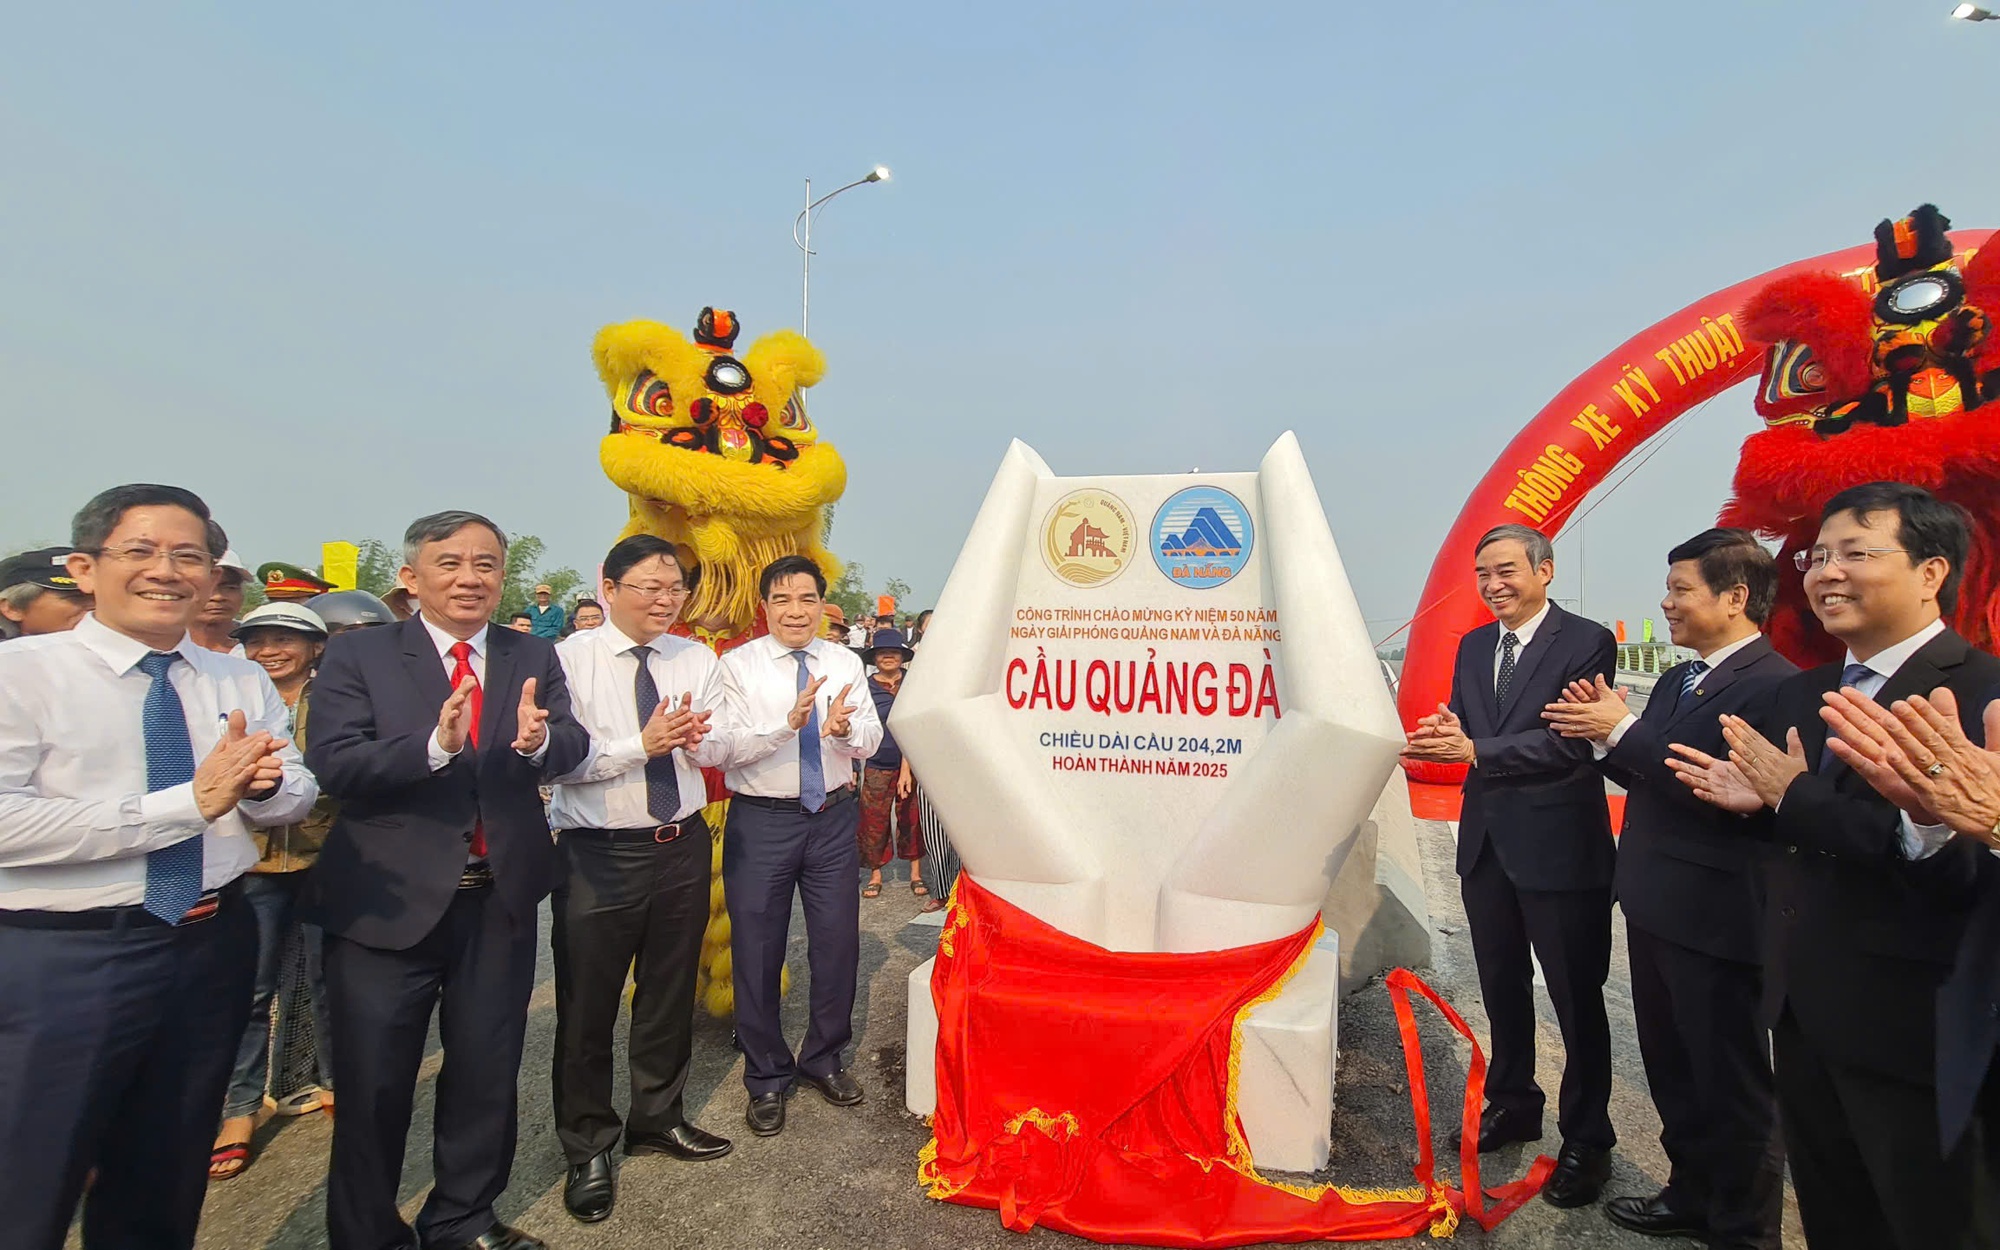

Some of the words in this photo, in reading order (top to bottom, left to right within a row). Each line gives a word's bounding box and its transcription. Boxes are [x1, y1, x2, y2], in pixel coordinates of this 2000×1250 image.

[1503, 444, 1585, 524] THÔNG
[1570, 403, 1622, 451] XE
[1611, 363, 1661, 419] KỸ
[1654, 312, 1745, 387] THUẬT
[1172, 563, 1191, 578] ĐÀ
[1016, 606, 1053, 621] CÔNG
[1054, 606, 1091, 621] TRÌNH
[1093, 606, 1130, 621] CHÀO
[1132, 606, 1172, 622] MỪNG
[1195, 607, 1228, 625] NIỆM
[1229, 609, 1244, 622] 50
[1246, 606, 1277, 623] NĂM
[1010, 623, 1045, 639] NGÀY
[1046, 624, 1071, 639] GIẢI
[1073, 624, 1119, 640] PHÓNG
[1120, 625, 1168, 640] QUẢNG
[1170, 627, 1200, 640] NAM
[1202, 625, 1220, 640] VÀ
[1222, 625, 1241, 641] ĐÀ
[1244, 624, 1281, 642] NẴNG
[1006, 646, 1076, 711] CẦU
[1085, 647, 1218, 716] QUẢNG
[1226, 647, 1282, 719] ĐÀ
[1099, 731, 1129, 750] DÀI
[1178, 736, 1242, 756] 204,2M
[1052, 753, 1096, 772] HOÀN
[1098, 754, 1152, 775] THÀNH
[1155, 758, 1190, 776] NĂM
[1192, 762, 1228, 778] 2025
